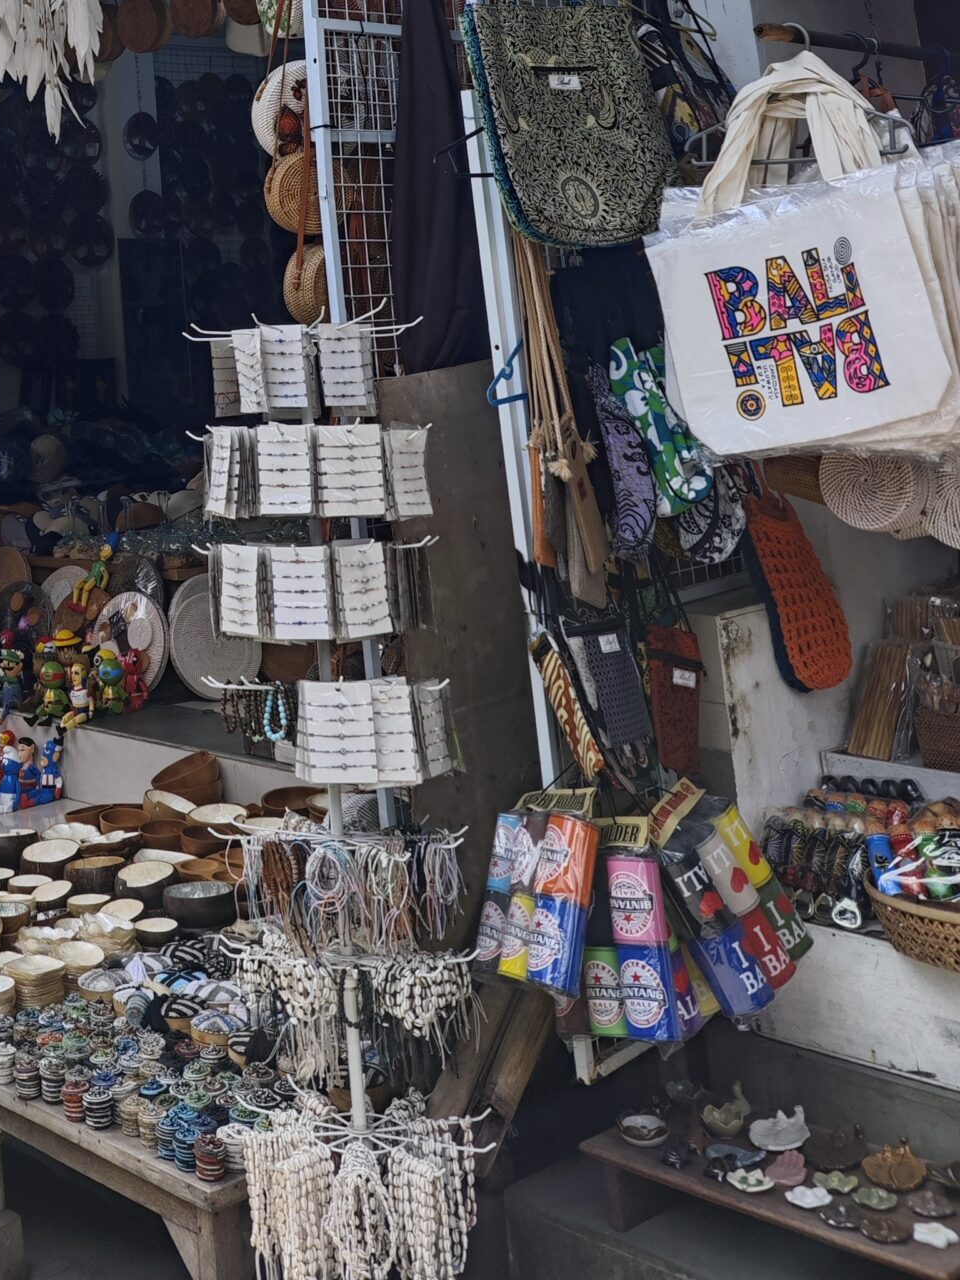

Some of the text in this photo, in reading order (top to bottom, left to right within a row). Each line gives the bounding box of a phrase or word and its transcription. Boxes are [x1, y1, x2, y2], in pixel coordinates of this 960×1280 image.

[756, 365, 766, 389] KUTA
[762, 365, 773, 400] ULUWATU
[724, 819, 749, 848] LI
[705, 841, 732, 874] LI
[674, 863, 711, 898] ALI
[776, 920, 807, 950] BA
[762, 951, 789, 978] BA
[586, 987, 623, 999] NTANG
[623, 987, 663, 1000] NTANG
[740, 968, 767, 995] BA
[677, 995, 699, 1021] AL
